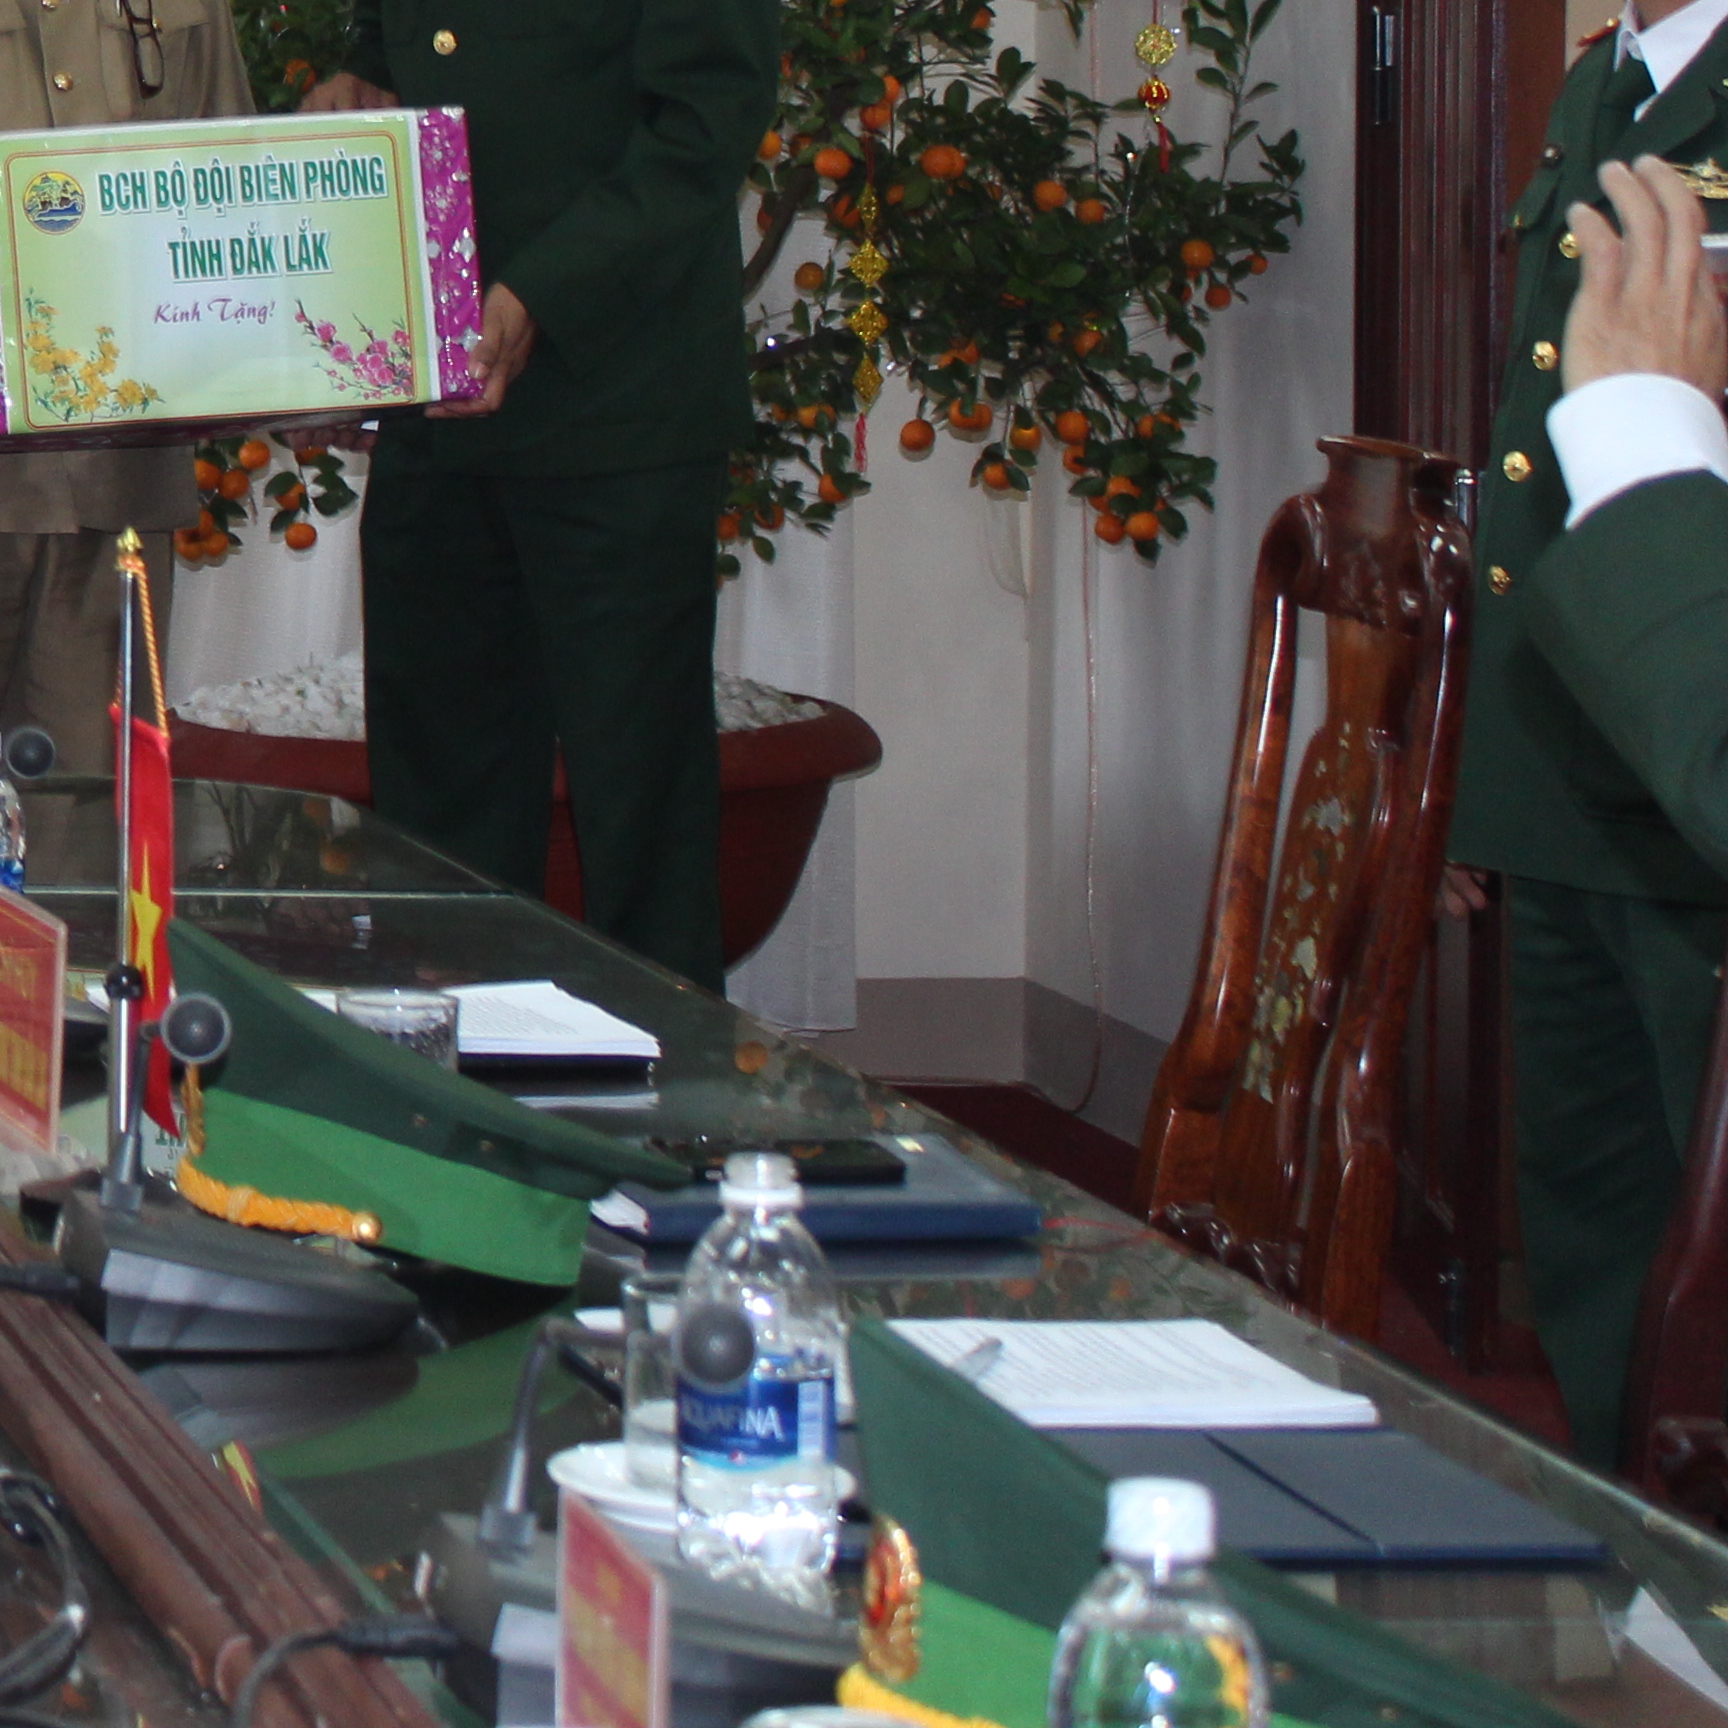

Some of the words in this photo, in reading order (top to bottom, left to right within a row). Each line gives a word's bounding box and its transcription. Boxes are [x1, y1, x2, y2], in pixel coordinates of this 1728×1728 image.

[97, 171, 147, 213] BCH
[154, 159, 187, 217] BỘ
[193, 158, 235, 215] ĐỘI
[238, 155, 296, 203] BIÊN
[302, 149, 386, 201] PHÒNG
[168, 225, 225, 281] TỈNH
[229, 220, 279, 277] ĐẮK
[283, 217, 332, 273] LẮK
[206, 297, 276, 326] Tặng!
